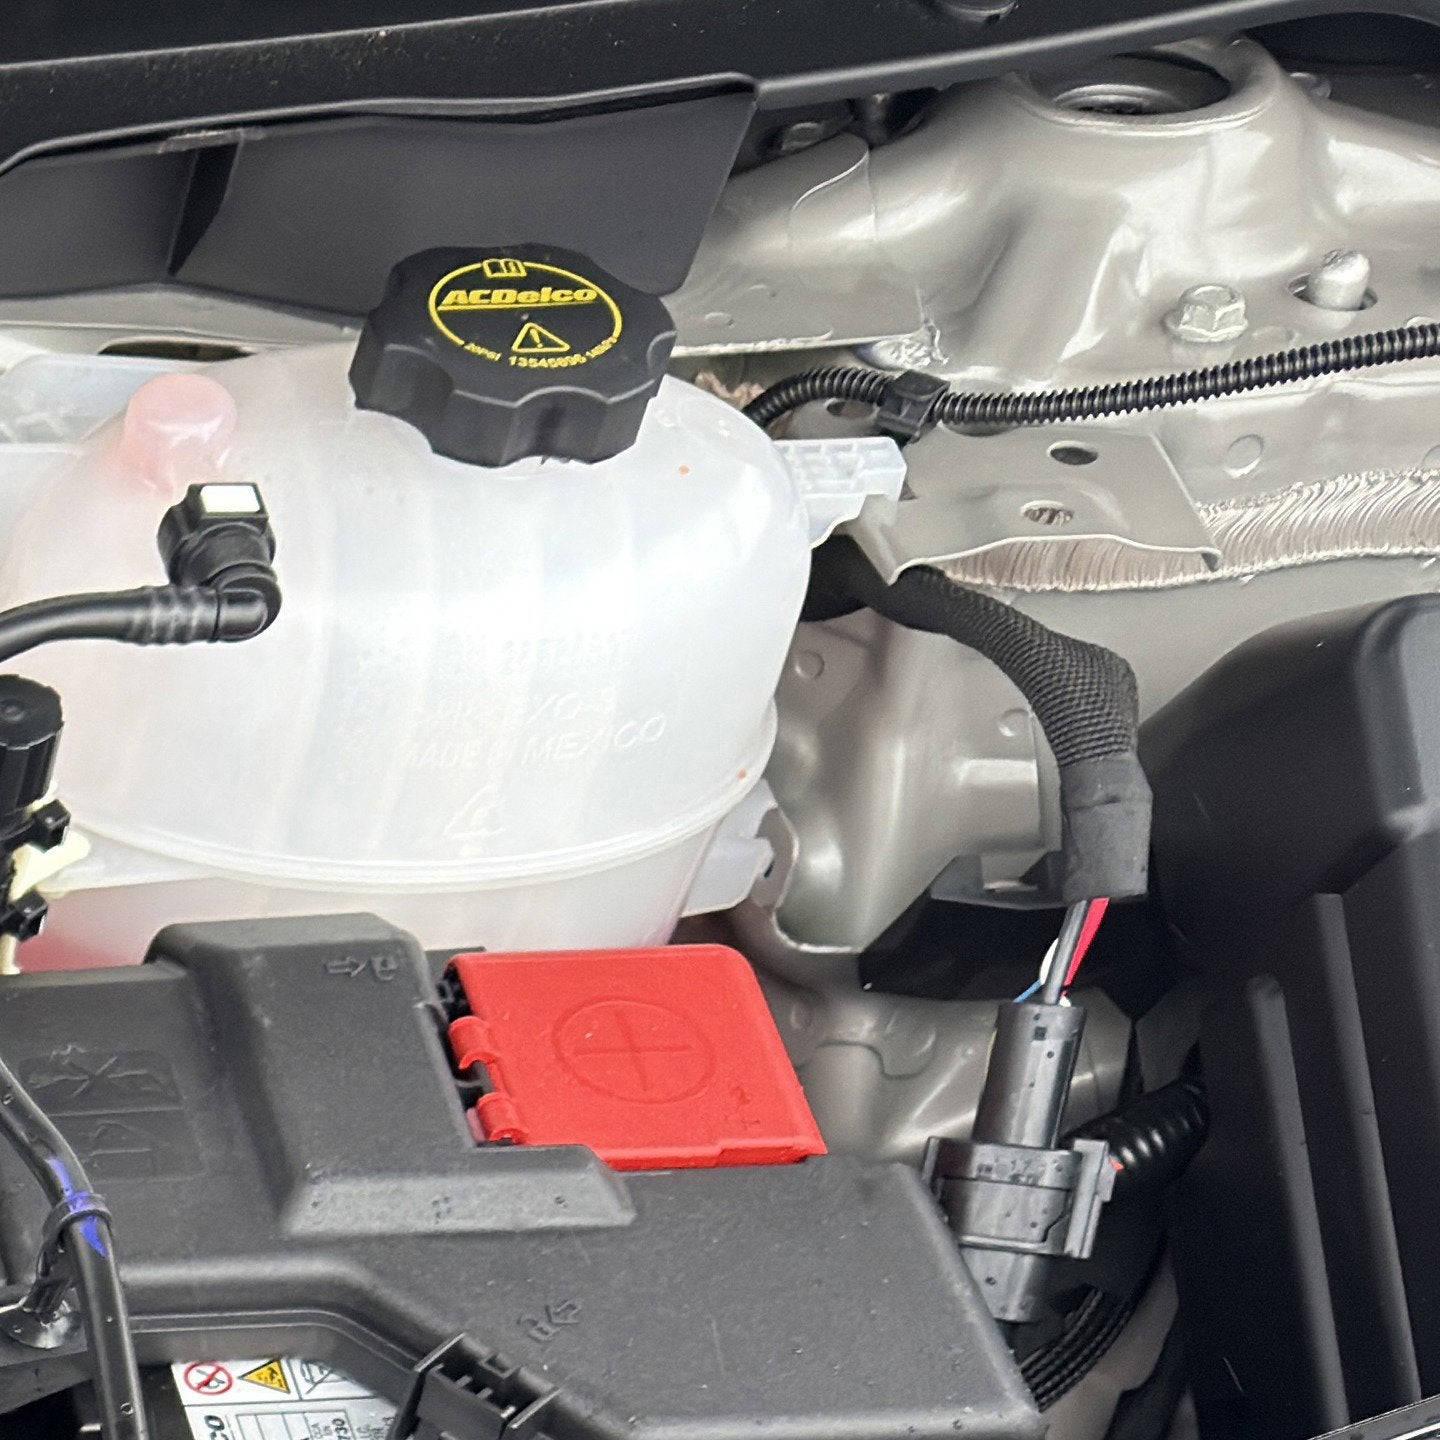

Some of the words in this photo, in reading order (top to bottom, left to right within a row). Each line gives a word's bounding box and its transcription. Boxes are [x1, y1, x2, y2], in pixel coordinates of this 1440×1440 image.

[441, 286, 598, 305] ACDelco
[521, 713, 667, 766] MEXICO
[331, 1418, 351, 1440] 730
